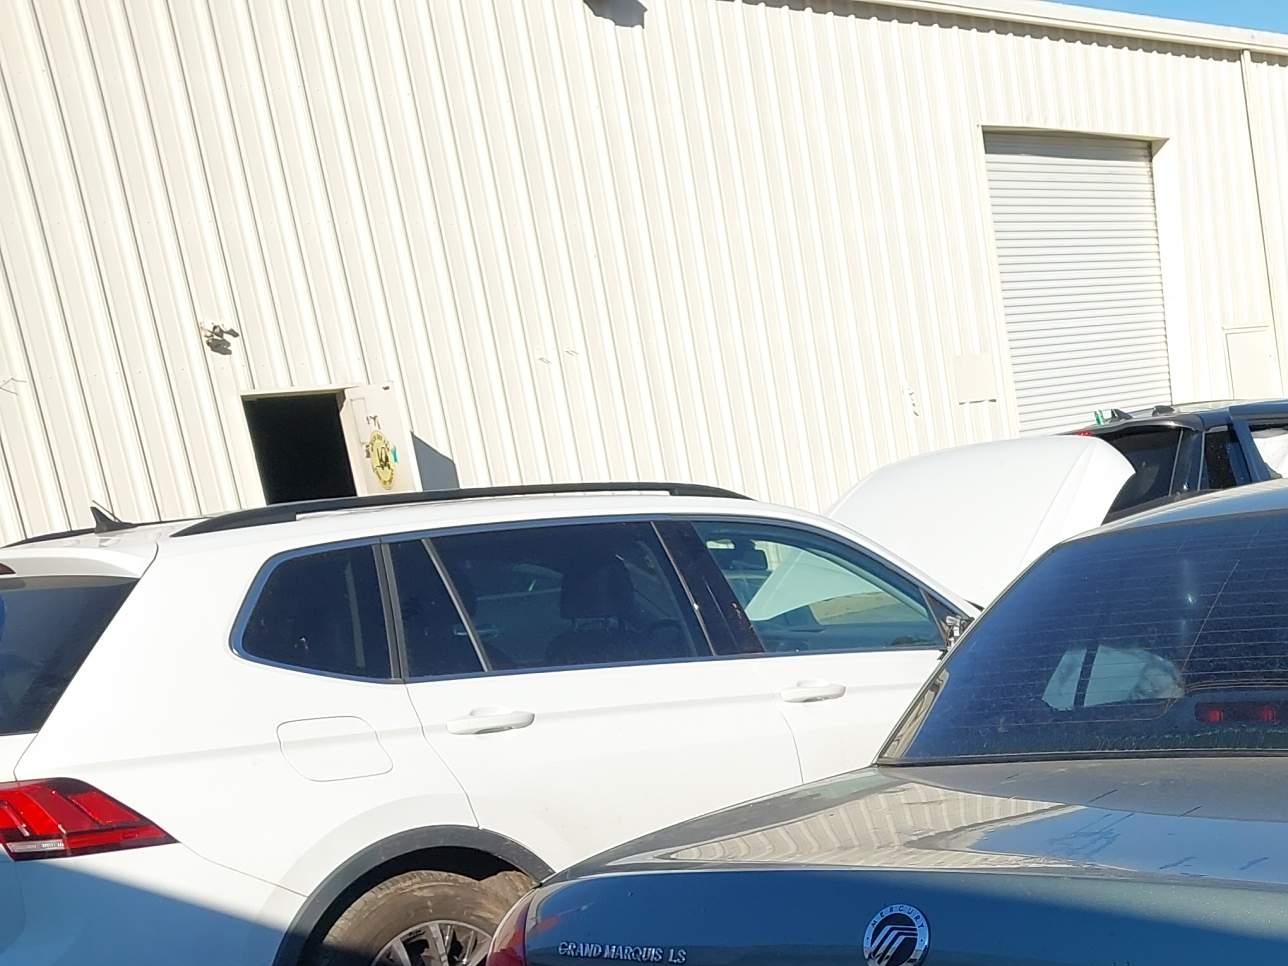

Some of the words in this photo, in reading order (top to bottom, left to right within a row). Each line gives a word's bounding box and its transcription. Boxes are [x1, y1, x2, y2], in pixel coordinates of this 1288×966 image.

[870, 905, 925, 929] MERCURY
[558, 941, 602, 958] GRAND
[603, 943, 664, 963] MARQUIS
[667, 947, 687, 964] LS
